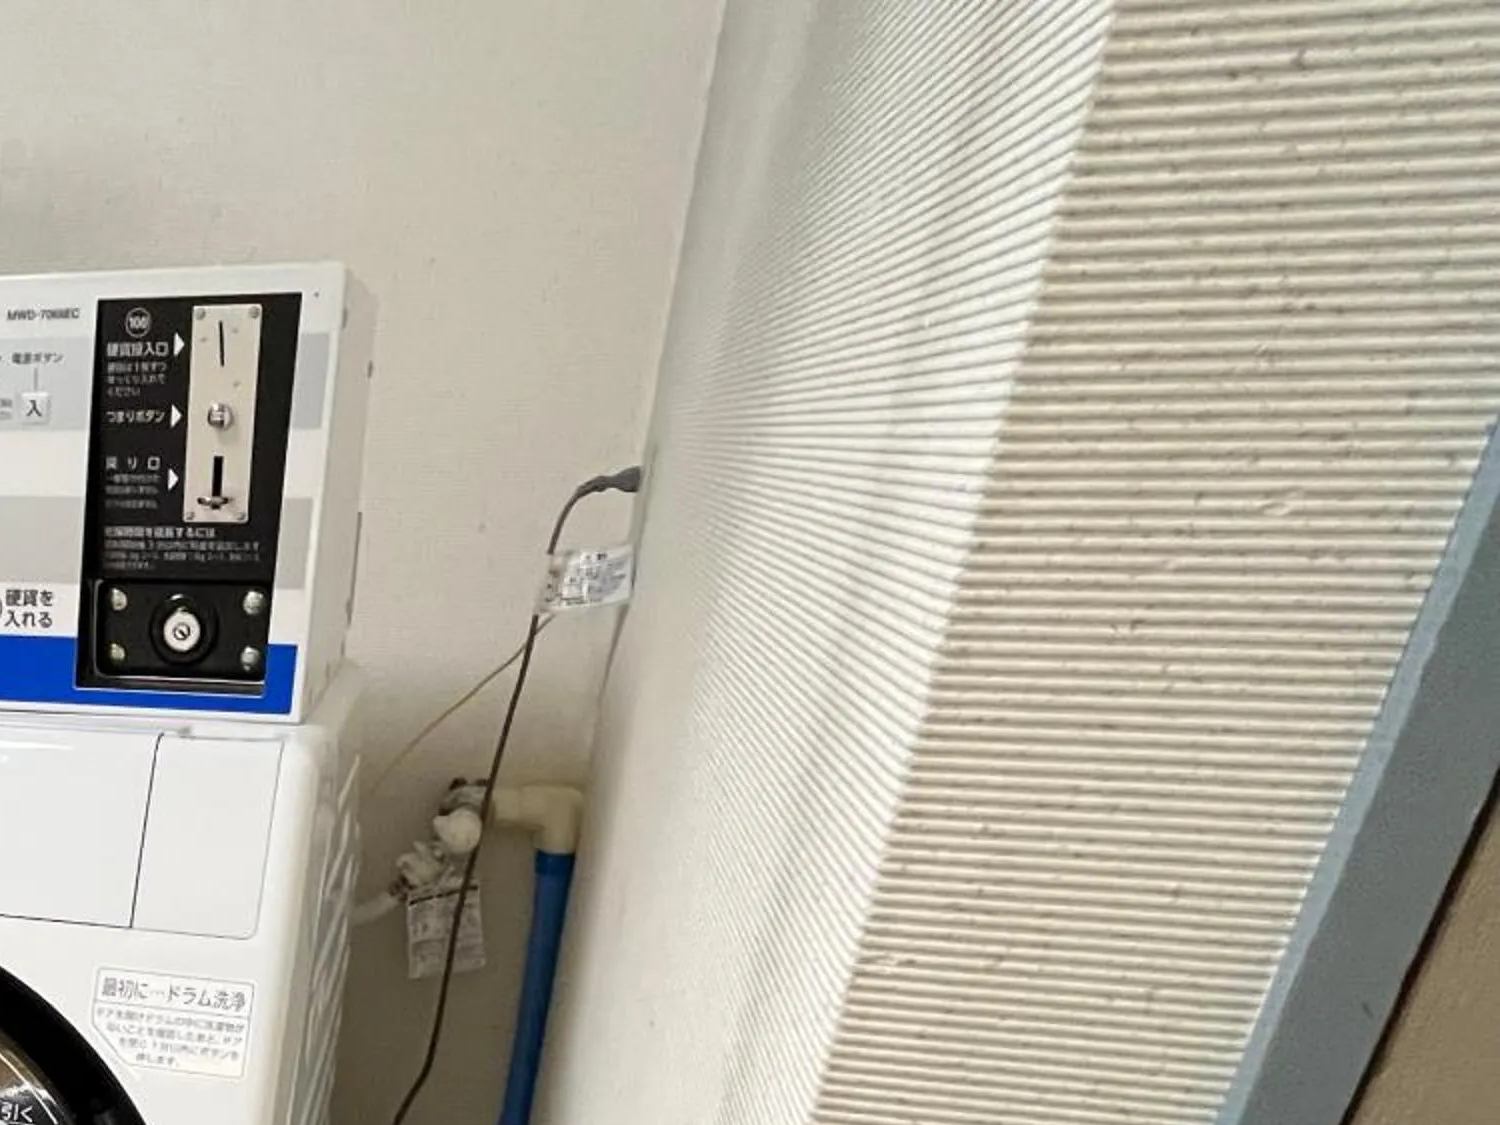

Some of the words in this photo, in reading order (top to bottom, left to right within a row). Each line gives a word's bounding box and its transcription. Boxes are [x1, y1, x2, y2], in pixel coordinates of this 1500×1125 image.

[128, 317, 149, 330] 100
[106, 410, 167, 423] つまりボタン
[6, 588, 53, 607] 硬貨を
[4, 610, 53, 628] 入れる
[1, 1102, 34, 1123] 引く
